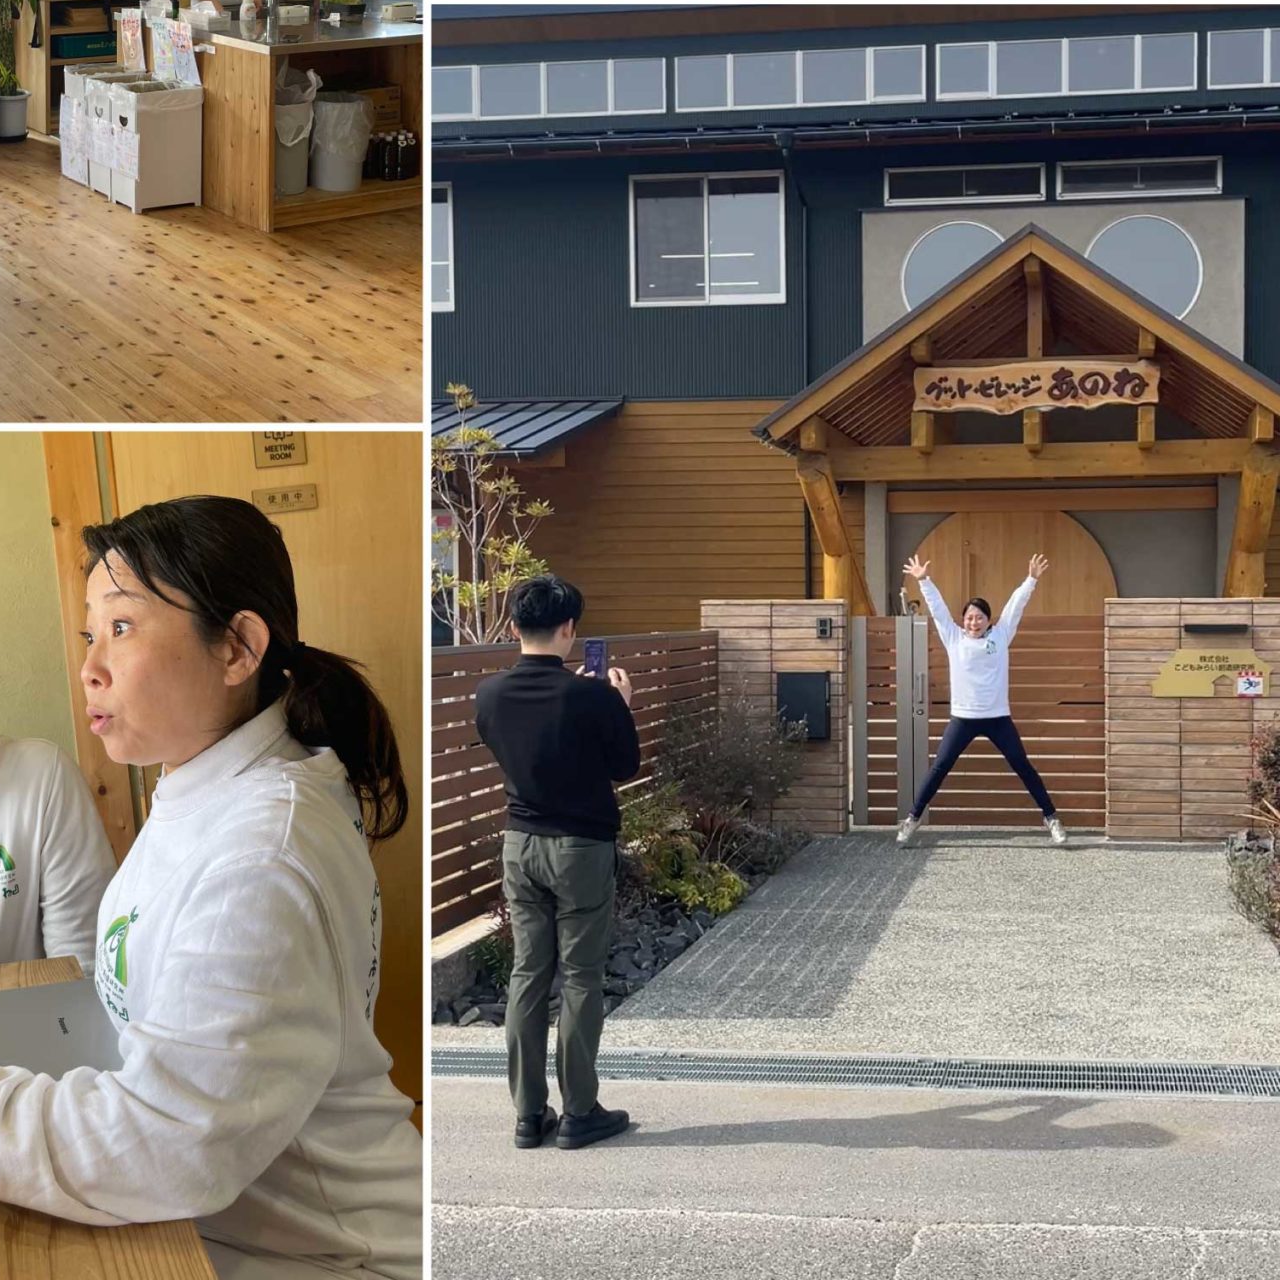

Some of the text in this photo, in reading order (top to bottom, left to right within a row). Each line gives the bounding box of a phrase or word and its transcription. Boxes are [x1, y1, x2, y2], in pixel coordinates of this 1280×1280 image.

[1048, 367, 1149, 400] あのね
[264, 443, 295, 453] MEETING
[270, 452, 292, 461] ROOM
